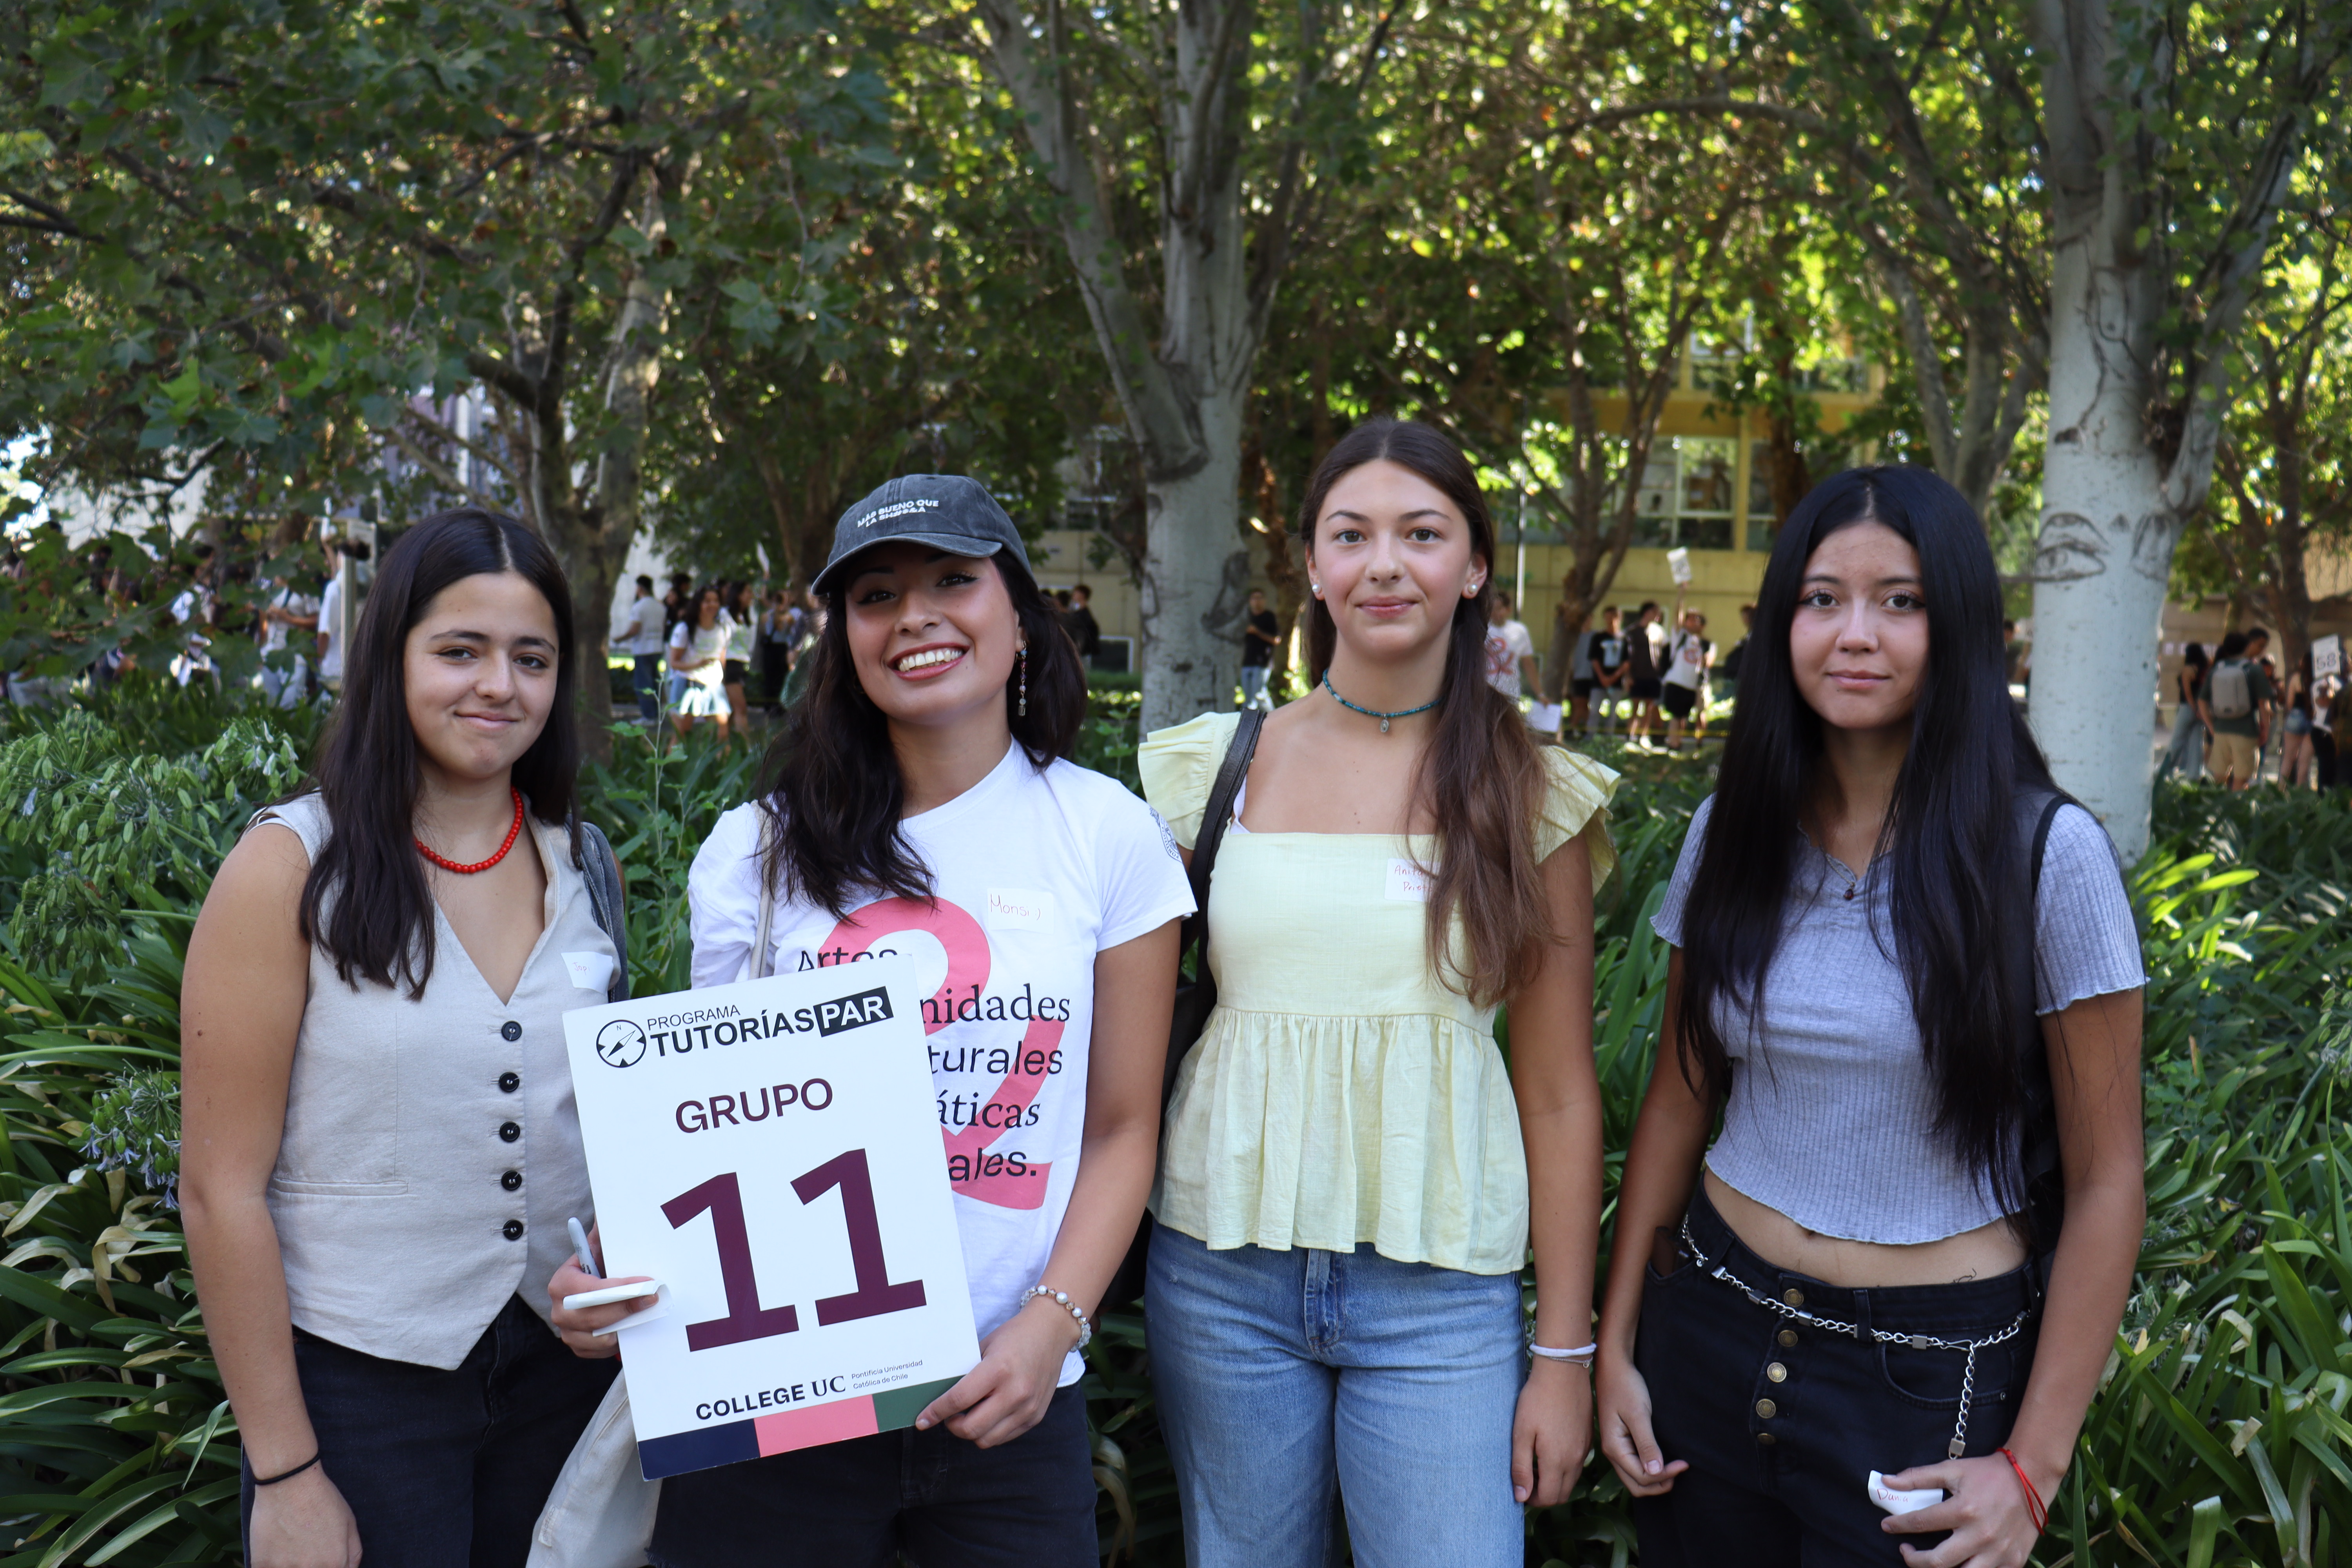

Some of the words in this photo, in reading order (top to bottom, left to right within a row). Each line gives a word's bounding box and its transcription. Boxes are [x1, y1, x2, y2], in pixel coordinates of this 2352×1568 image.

[878, 501, 915, 515] BUENO
[866, 517, 877, 527] LA
[991, 893, 1029, 916] Monsi
[647, 1004, 740, 1031] PROGRAMA
[675, 1078, 833, 1133] GRUPO
[660, 1148, 927, 1352] 11
[851, 1368, 883, 1379] Pontificia
[884, 1359, 923, 1372] Universidad
[853, 1379, 880, 1389] Católica
[891, 1373, 908, 1381] Chile
[696, 1384, 805, 1419] COLLEGE
[809, 1376, 846, 1396] UC
